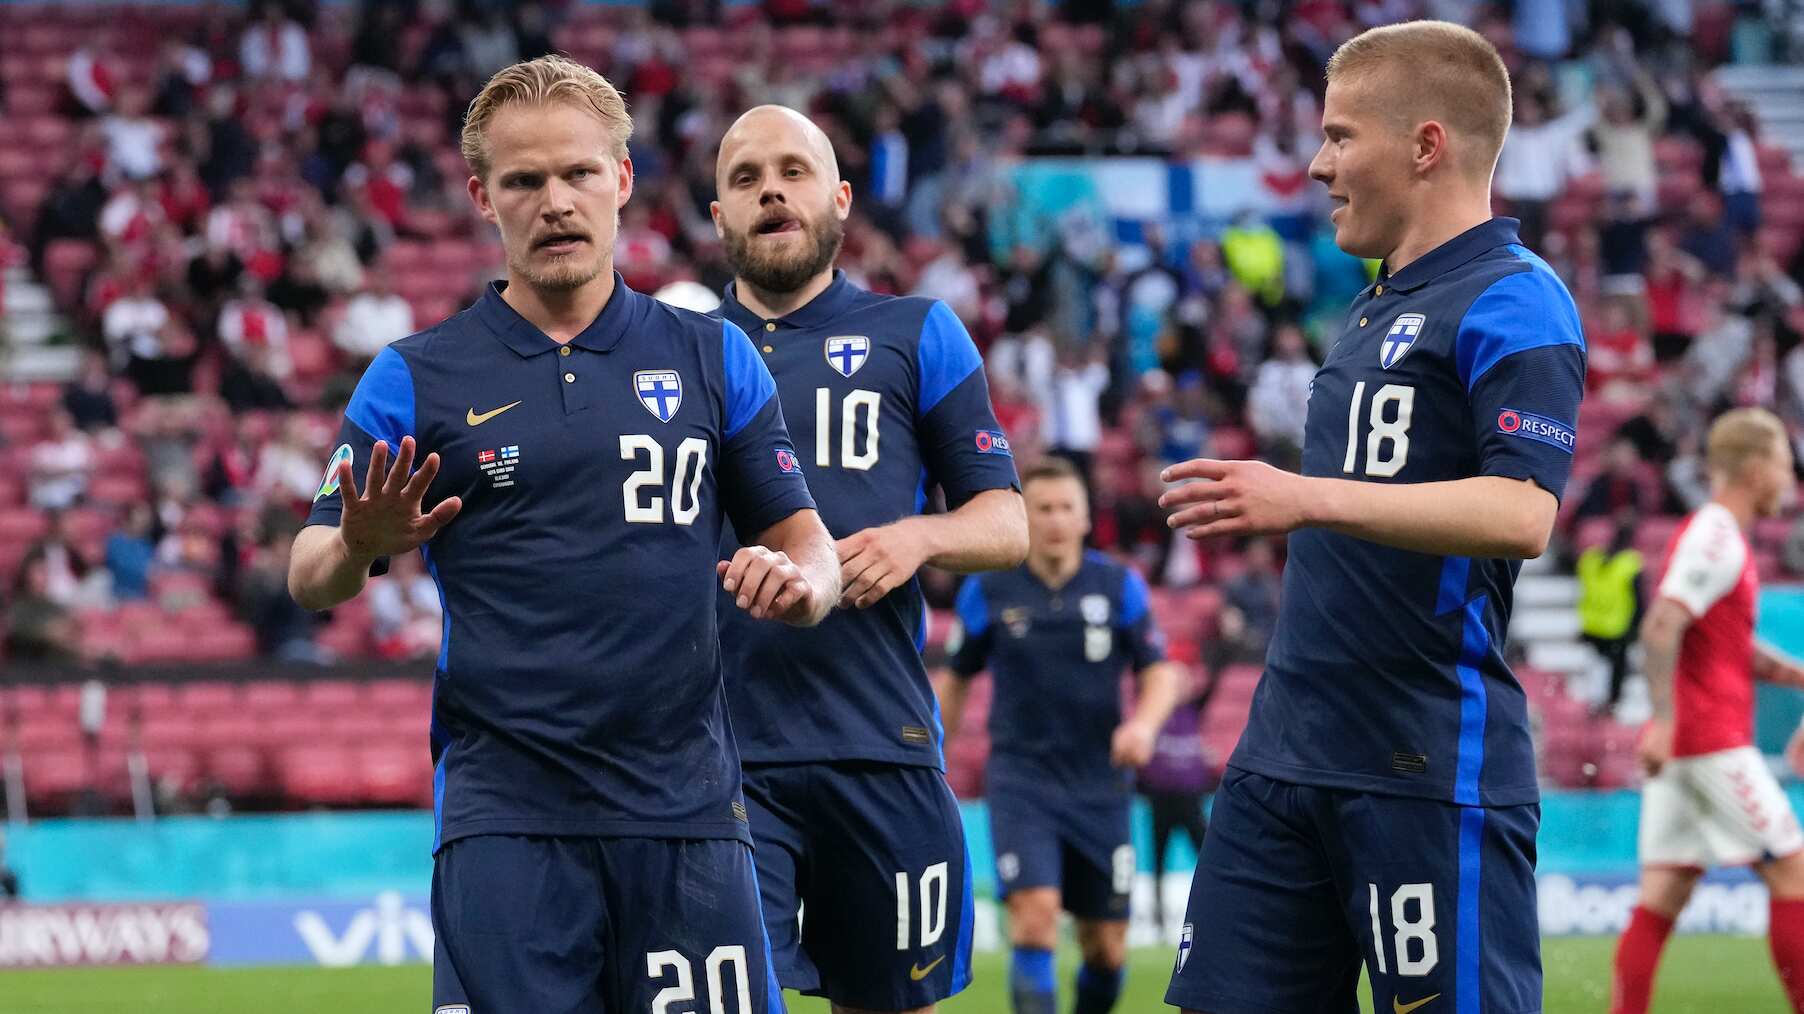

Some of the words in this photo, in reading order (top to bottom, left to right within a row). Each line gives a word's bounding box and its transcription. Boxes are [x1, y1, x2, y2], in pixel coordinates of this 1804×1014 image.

[816, 387, 881, 471] 10
[1342, 381, 1415, 477] 18
[1522, 418, 1575, 447] RESPECT
[619, 434, 708, 526] 20
[895, 861, 948, 950] 10
[1368, 883, 1439, 976] 18
[646, 945, 752, 1014] 20
